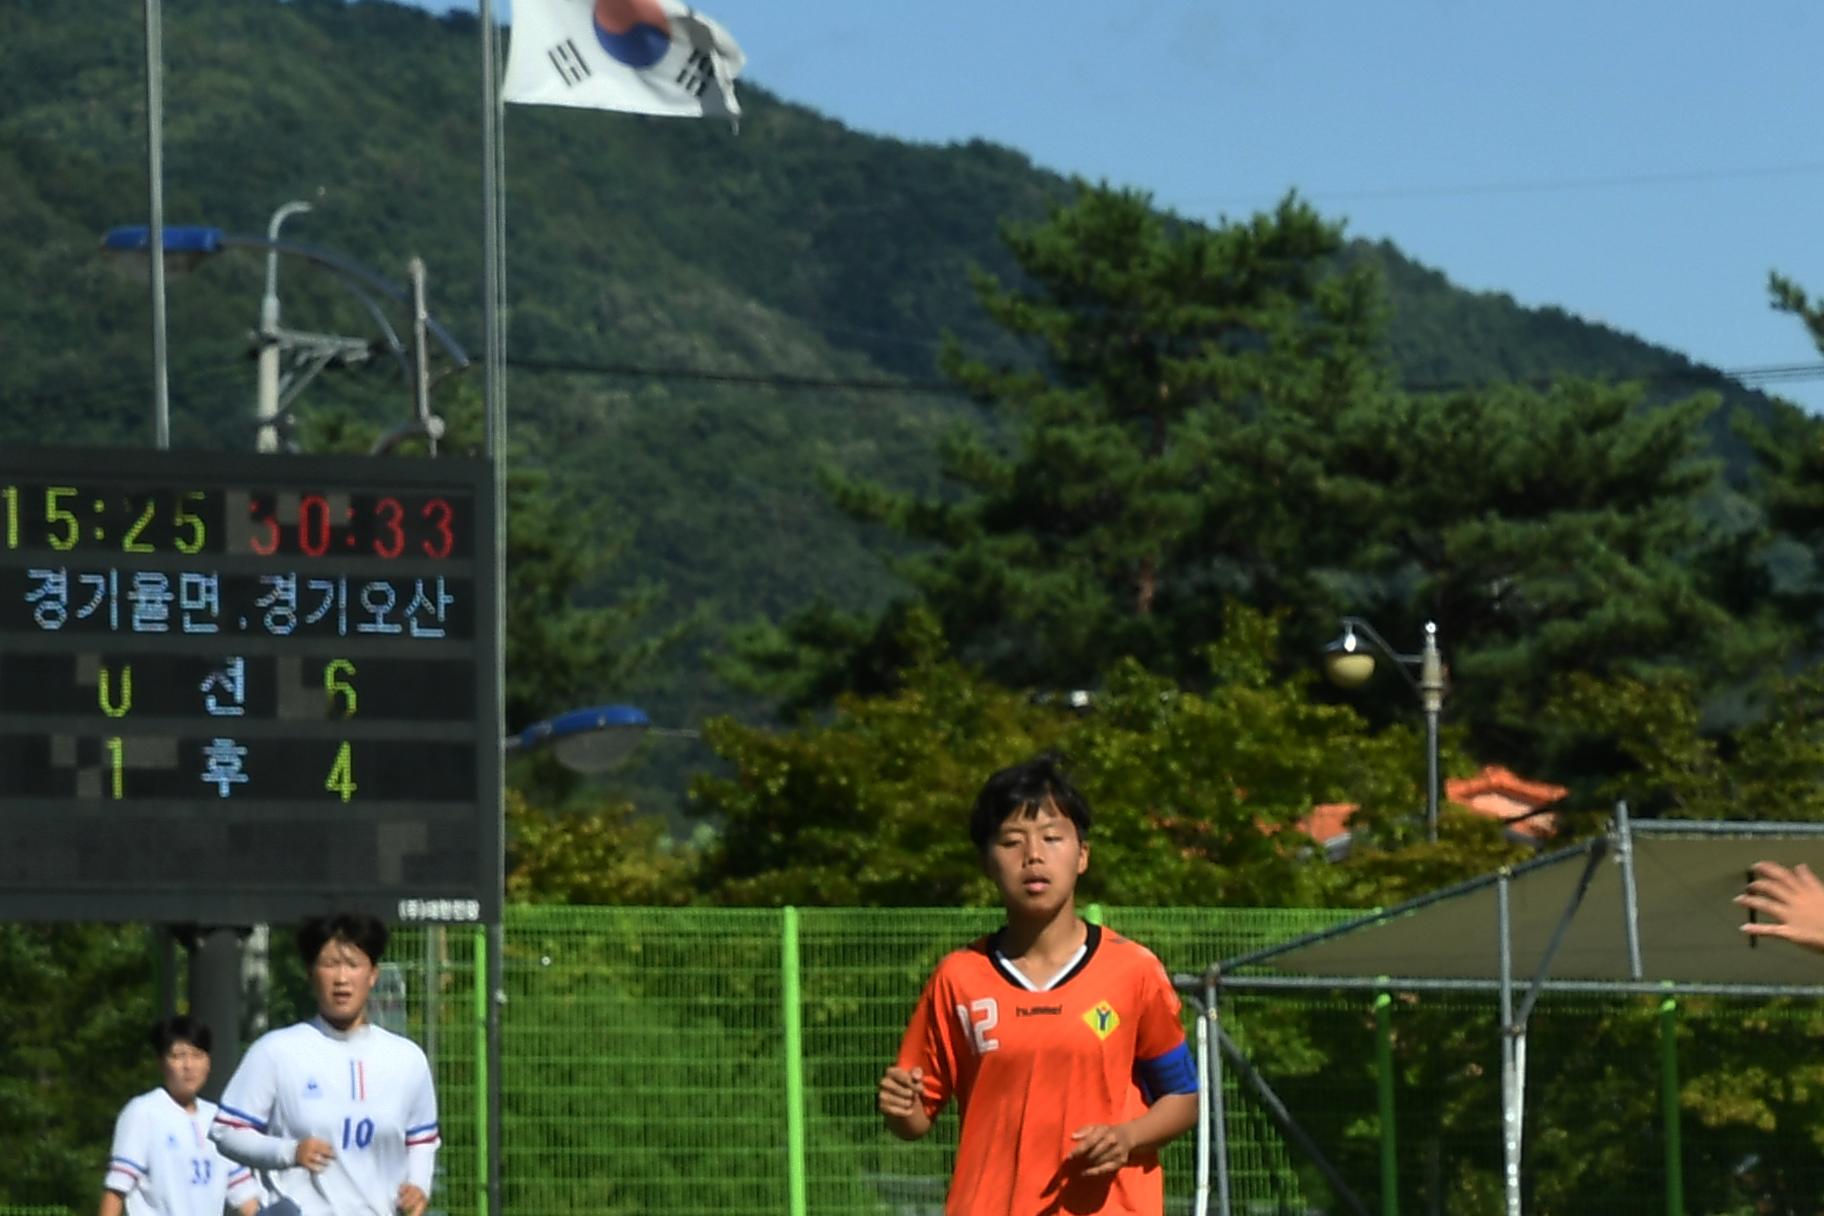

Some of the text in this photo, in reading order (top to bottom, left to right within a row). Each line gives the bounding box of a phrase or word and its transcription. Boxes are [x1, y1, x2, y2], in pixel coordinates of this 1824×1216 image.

[2, 486, 205, 553] 15:25
[255, 571, 455, 637] 경기오산
[106, 736, 358, 802] 1 후 4
[957, 997, 999, 1054] 12
[342, 1117, 375, 1149] 10
[191, 1160, 211, 1185] 33
